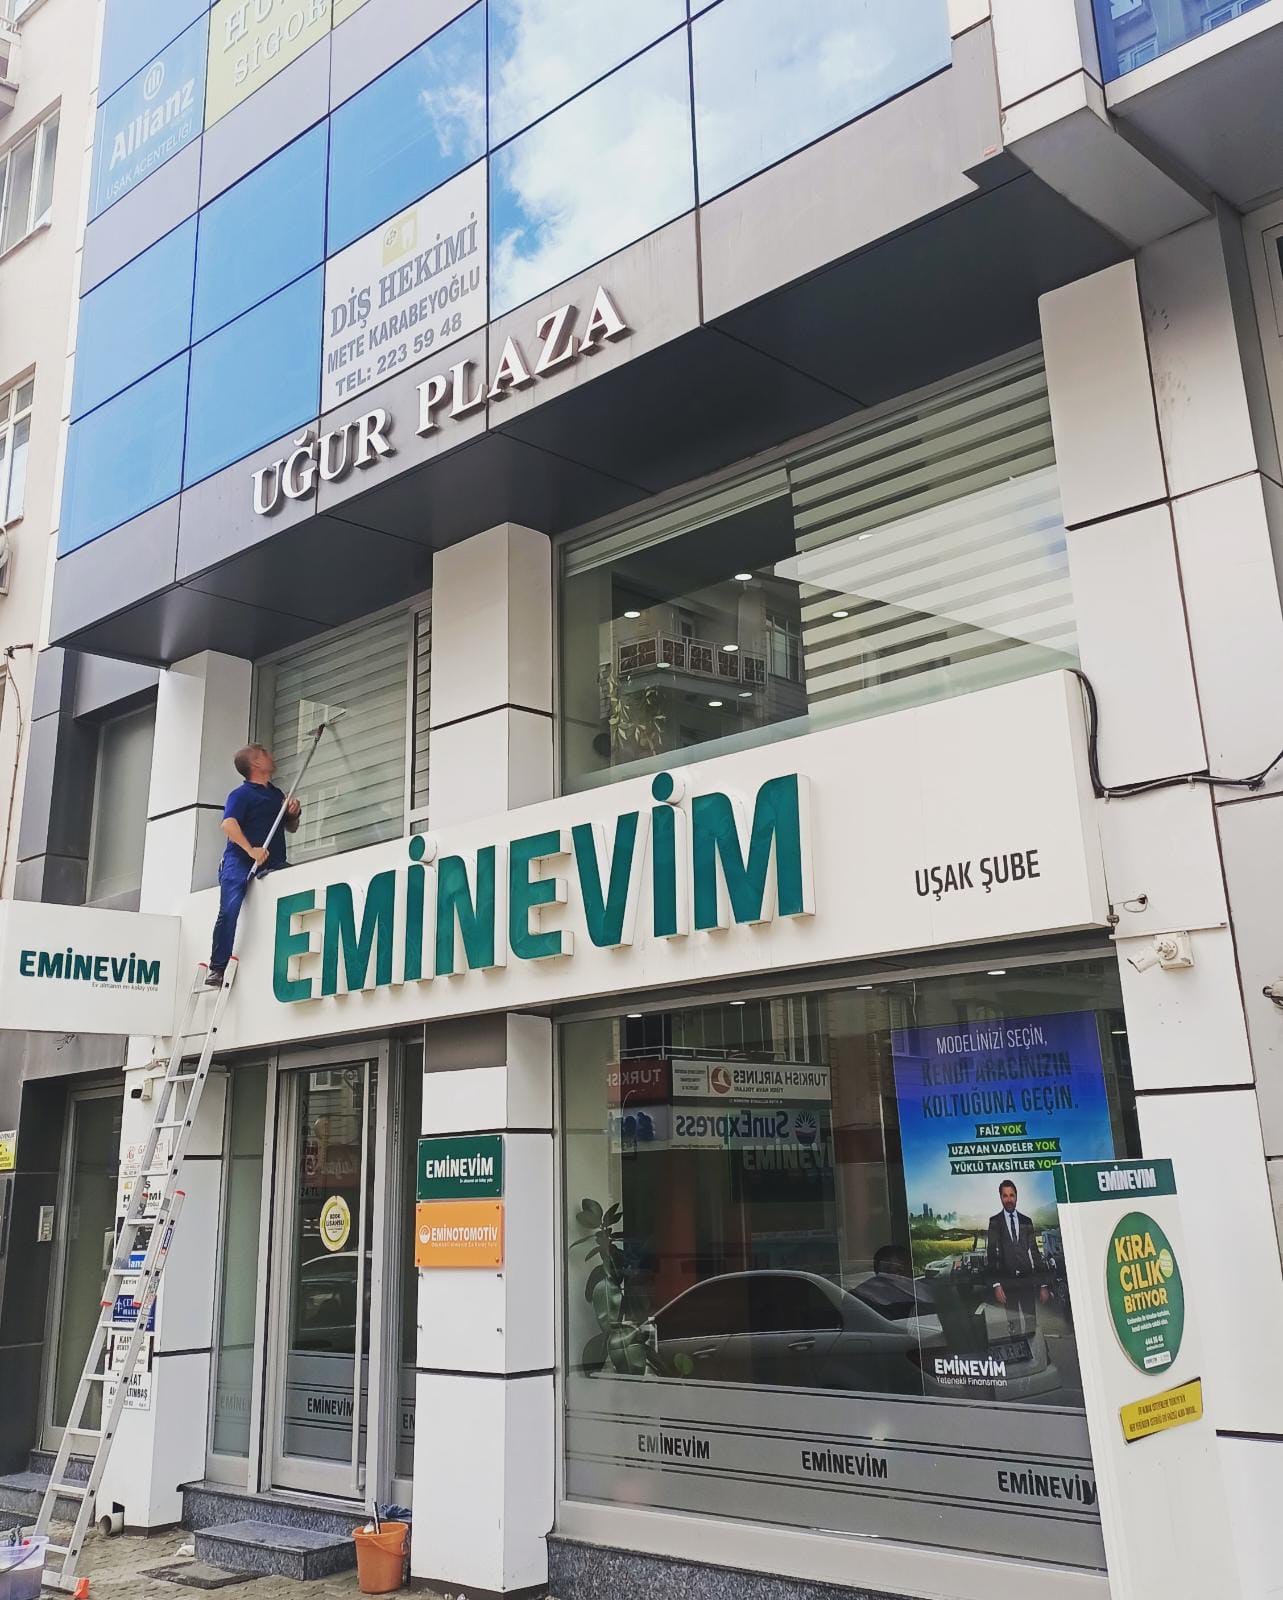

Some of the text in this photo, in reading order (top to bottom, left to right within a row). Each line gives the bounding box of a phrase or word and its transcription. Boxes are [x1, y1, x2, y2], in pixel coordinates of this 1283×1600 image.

[109, 78, 195, 172] Allianz
[330, 211, 478, 338] DİŞ HEKİMİ
[327, 265, 480, 375] METE KARABEYOĞLU
[335, 312, 462, 397] TEL: 223 59 48
[251, 284, 629, 516] UĞUR PLAZA
[272, 771, 814, 1003] EMİNEVİM
[915, 849, 1041, 902] UŞAK ŞUBE
[19, 947, 161, 986] EMİNEVİM
[936, 1023, 1048, 1055] MODELİNİZİ SEÇİN,
[922, 1087, 1017, 1119] KOLTUĞUNA
[979, 1123, 1022, 1136] FAİZ YOK
[951, 1141, 1057, 1156] UZAYAN VADELER YOK
[425, 1152, 494, 1179] EMİNEVİM
[953, 1160, 984, 1173] YÜKLÜ
[985, 1158, 1035, 1172] TAKSİTLER
[431, 1223, 498, 1242] EMİNOTOMOTİV
[1114, 1232, 1157, 1264] KİRA
[1120, 1259, 1165, 1292] CILIK
[1123, 1287, 1169, 1314] BİTİYOR
[934, 1354, 1006, 1377] EMİNEVİM
[935, 1375, 1008, 1387] Yetenekli Finansman
[638, 1431, 711, 1460] EMİNEVİM
[801, 1448, 889, 1479] EMİNEVİM
